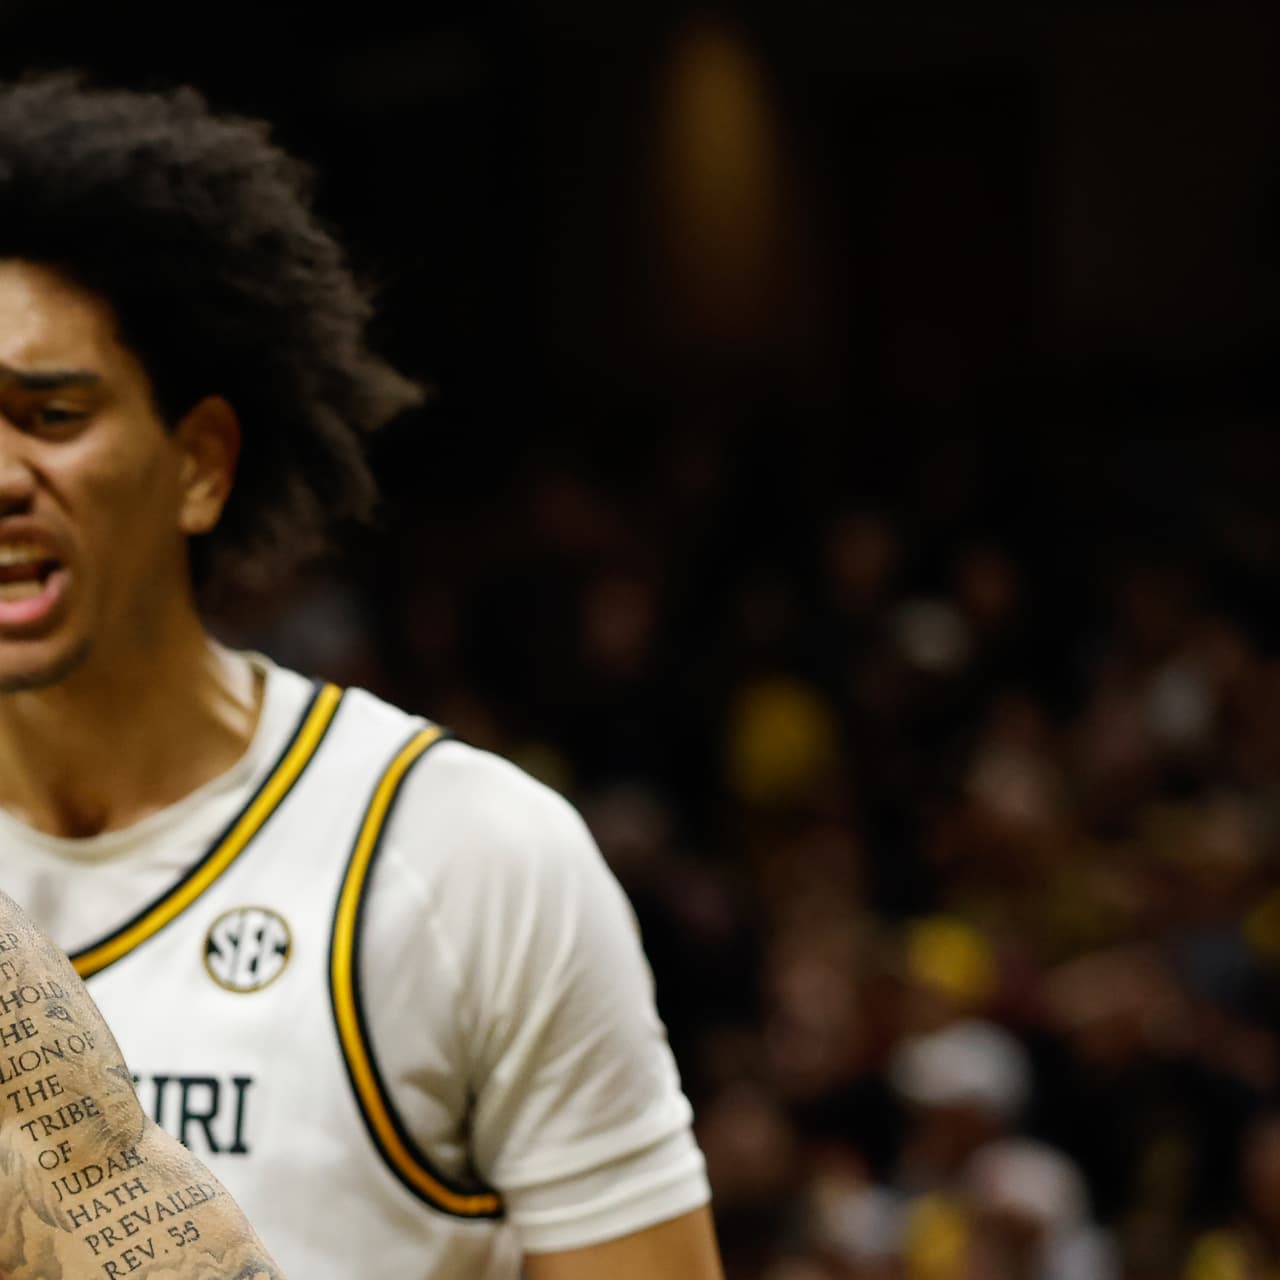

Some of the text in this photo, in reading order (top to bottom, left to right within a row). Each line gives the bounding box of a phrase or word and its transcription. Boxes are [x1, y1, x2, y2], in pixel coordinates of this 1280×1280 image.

[67, 1030, 96, 1055] OF
[6, 1074, 65, 1114] THE
[20, 1096, 101, 1142] TRIBE
[38, 1140, 73, 1171] OF
[66, 1177, 150, 1229] HATH
